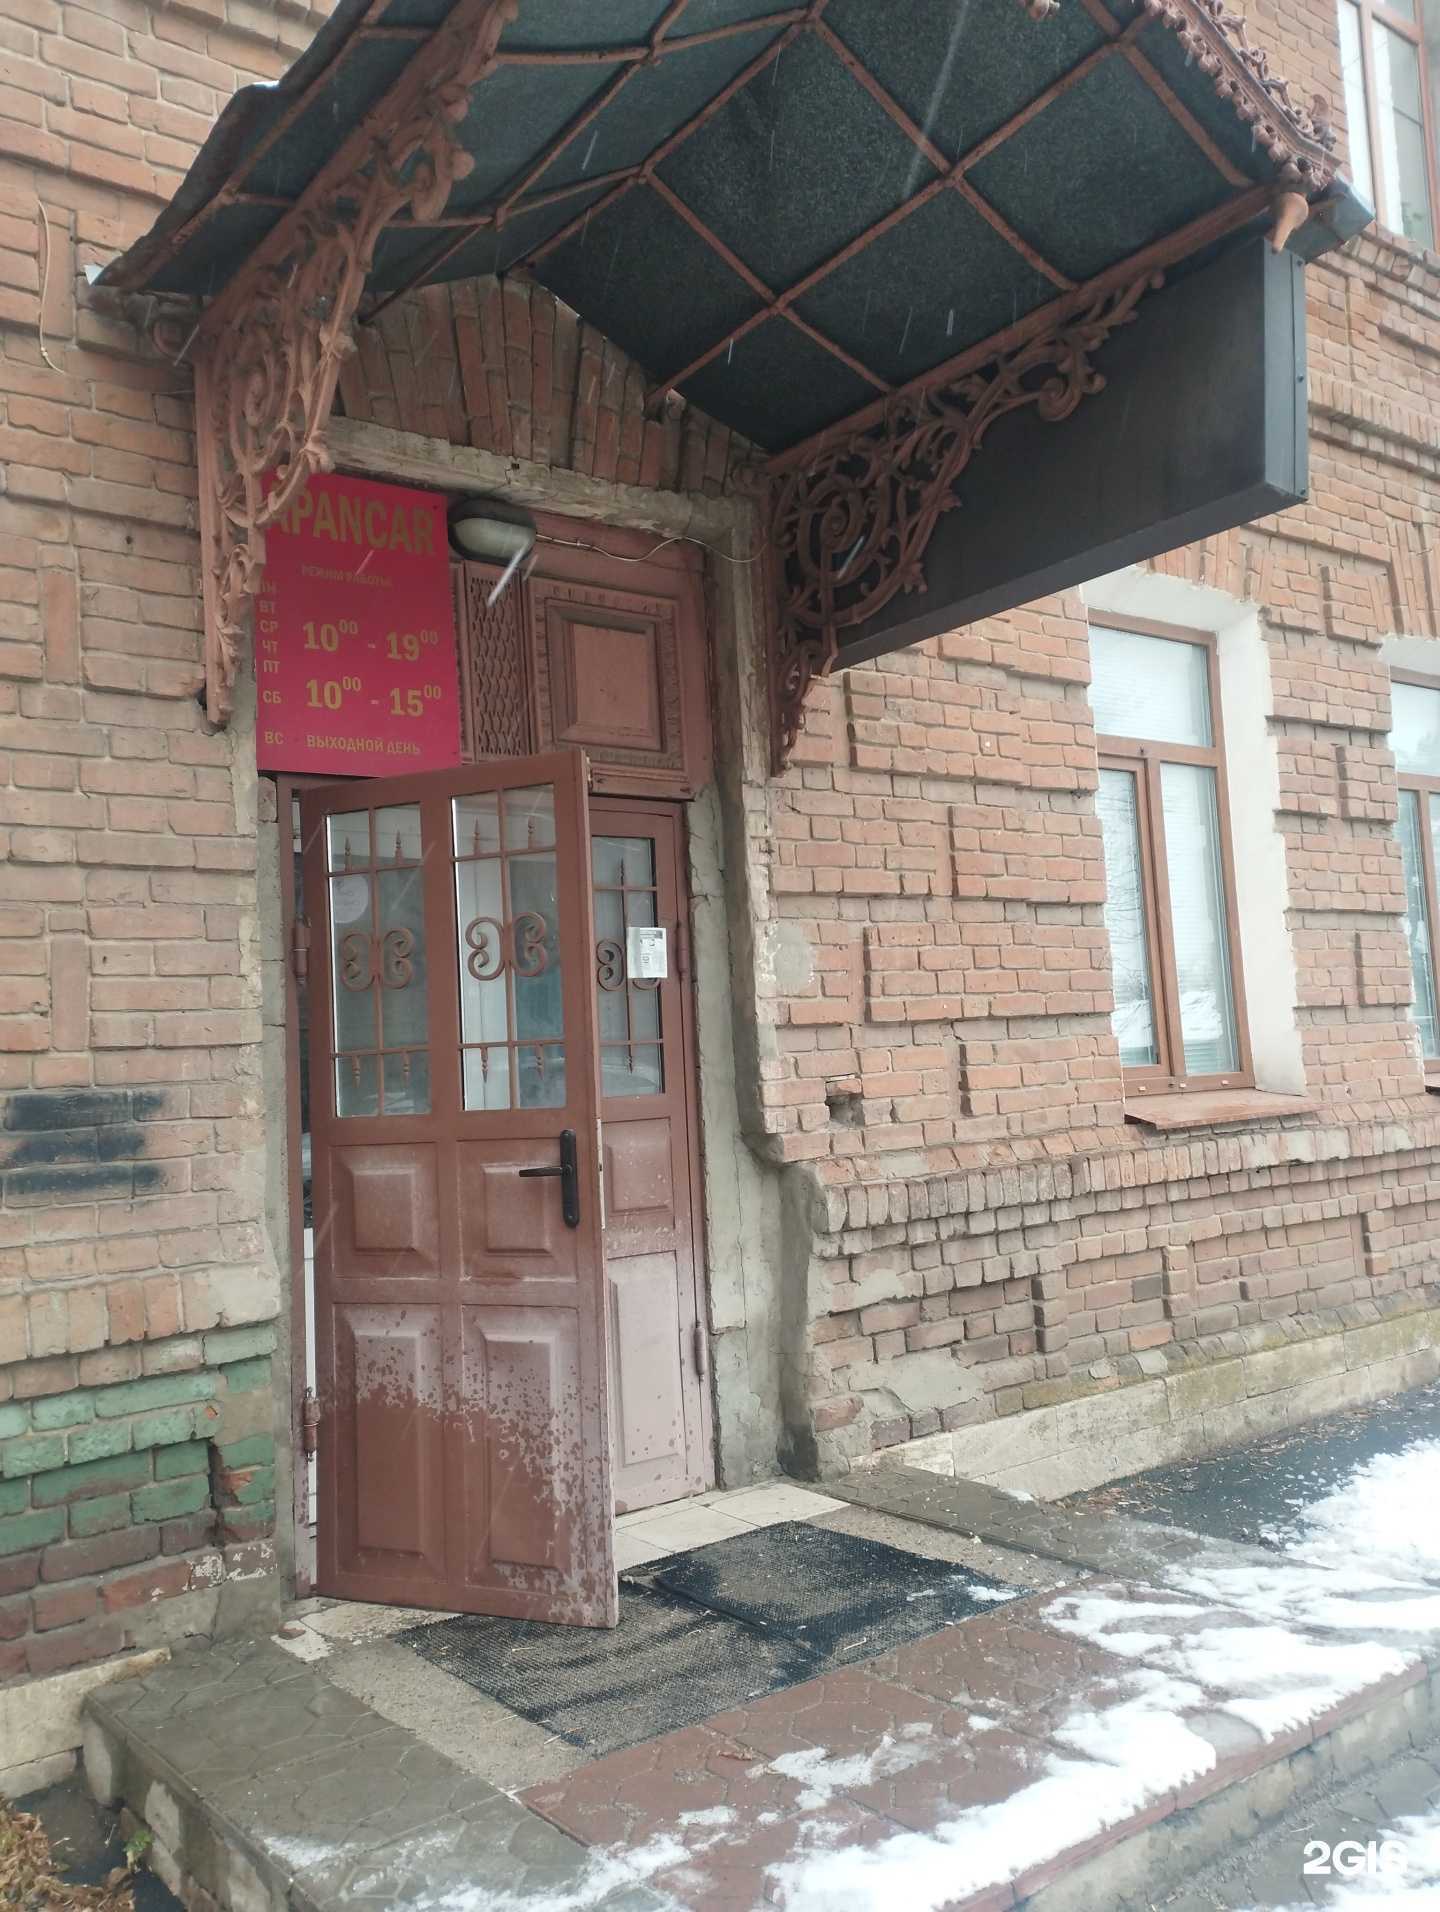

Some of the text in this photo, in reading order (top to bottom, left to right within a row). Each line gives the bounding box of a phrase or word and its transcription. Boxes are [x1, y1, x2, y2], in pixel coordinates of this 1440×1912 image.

[259, 600, 276, 613] ВТ
[260, 620, 278, 633] СР
[262, 640, 278, 654] ЧТ
[263, 660, 280, 674] ПТ
[262, 690, 282, 705] СБ
[264, 731, 420, 755] ВС ВЫХОДНОЙ ДЕНЬ
